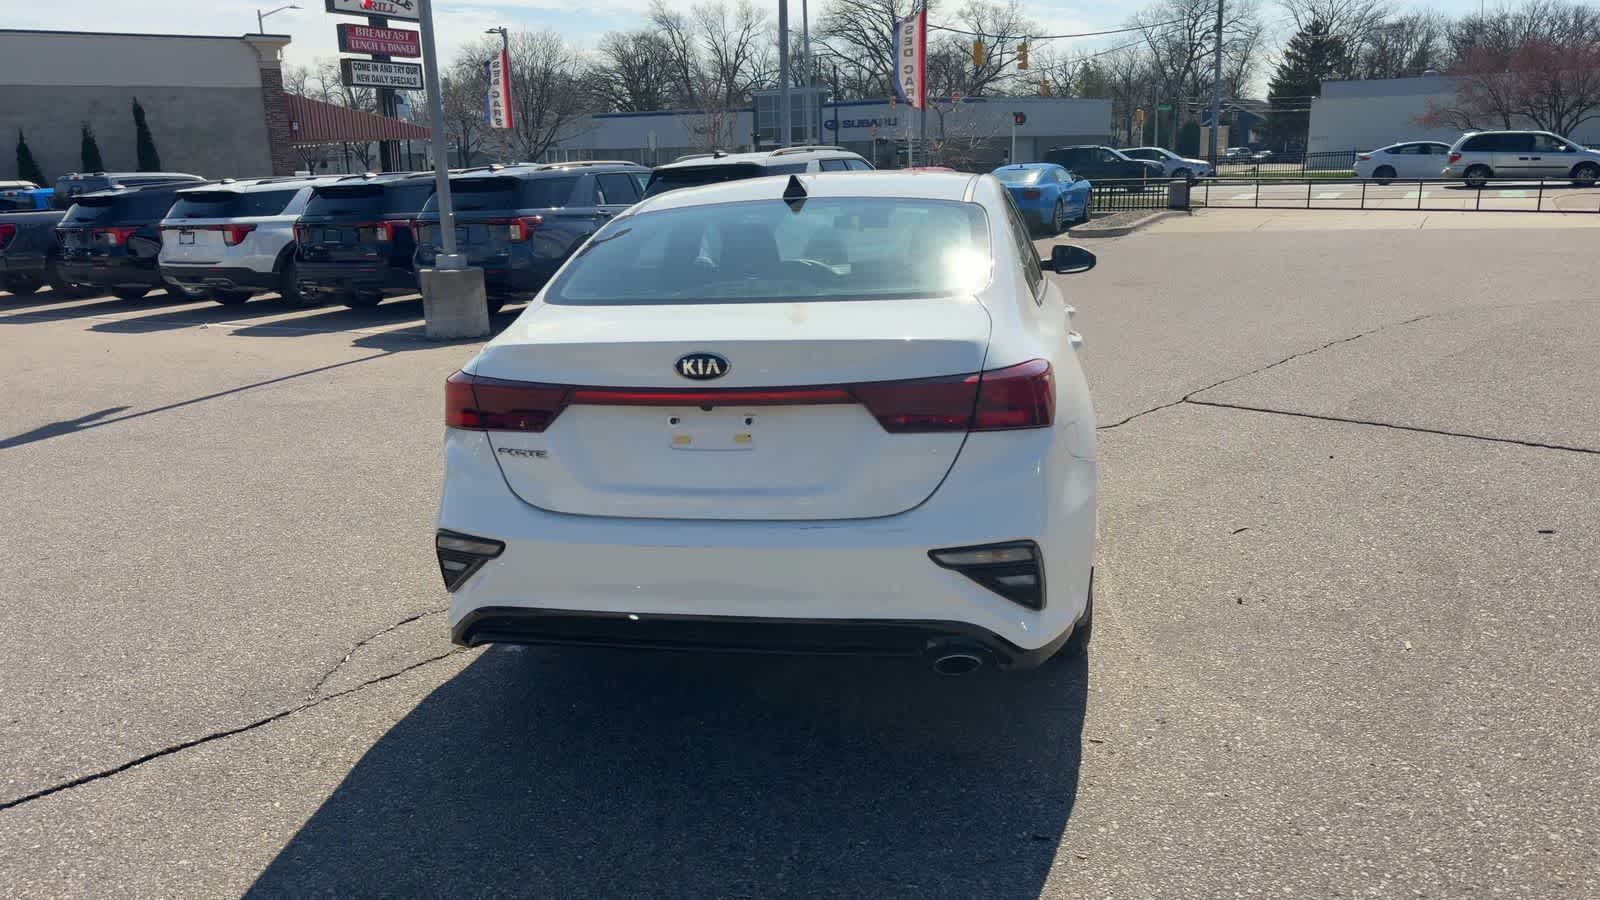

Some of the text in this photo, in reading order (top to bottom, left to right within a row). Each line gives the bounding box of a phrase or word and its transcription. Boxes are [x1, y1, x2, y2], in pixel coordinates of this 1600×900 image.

[355, 27, 410, 41] BREAKFAST
[351, 39, 416, 54] LUNCH & DINNER
[352, 62, 418, 75] COME IN AND TRY OUR
[356, 73, 417, 85] NEW DAILY SPECIALS
[842, 117, 898, 129] SUBARU
[682, 359, 721, 375] KIA
[498, 447, 547, 458] FORTE
